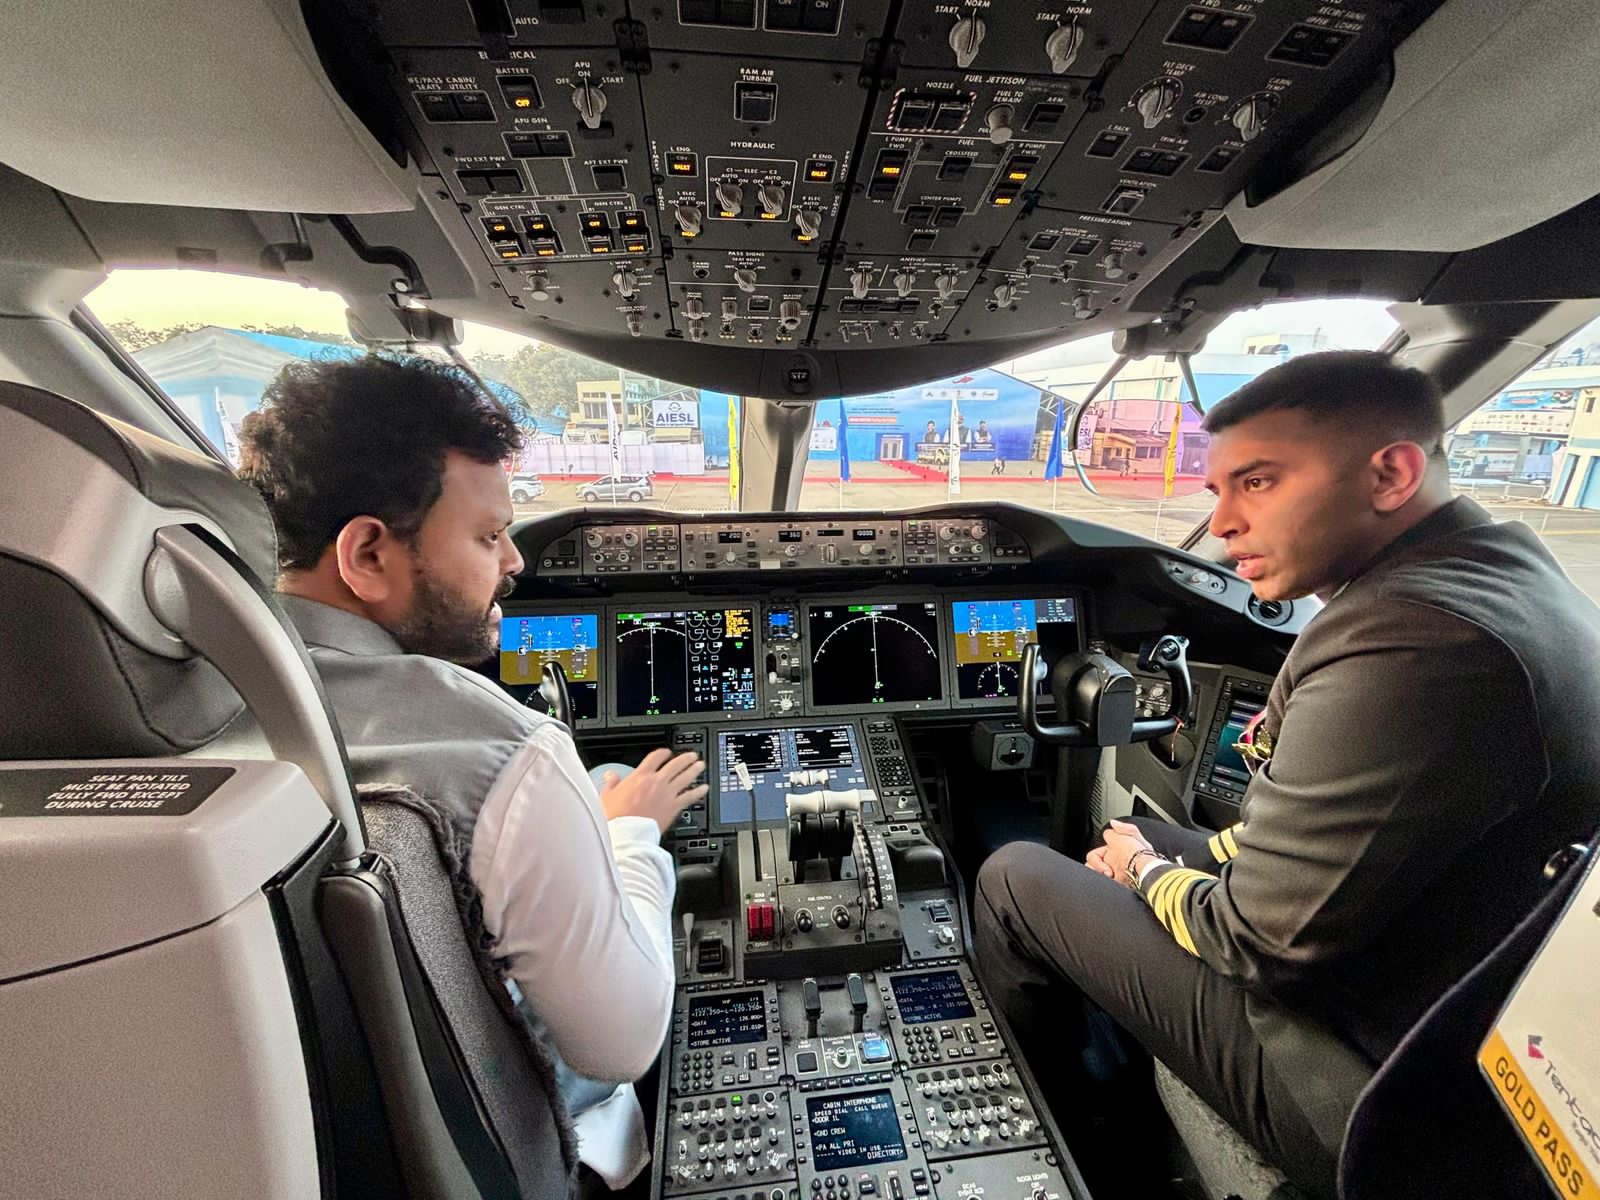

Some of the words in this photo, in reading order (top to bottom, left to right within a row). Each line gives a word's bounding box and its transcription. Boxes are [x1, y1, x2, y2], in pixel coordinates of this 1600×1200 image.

[815, 0, 829, 8] ON
[965, 0, 990, 8] NORM
[935, 5, 959, 14] START
[1066, 6, 1093, 15] NORM
[515, 17, 539, 25] AUTO
[1036, 13, 1060, 21] START
[575, 61, 590, 69] APU
[496, 67, 529, 75] BATTERY
[601, 76, 625, 84] START
[964, 75, 983, 83] FUEL
[985, 77, 1026, 85] JETTISON
[514, 117, 530, 125] APU
[730, 141, 776, 150] HYDRAULIC
[1079, 215, 1132, 226] PRESSURIZATION
[656, 413, 694, 423] AIESL
[61, 783, 104, 791] MUST
[47, 792, 93, 800] FULLY
[44, 801, 107, 809] DURING
[823, 1101, 841, 1109] CABIN
[844, 1097, 877, 1106] INTERPHONE
[1495, 1057, 1536, 1121] GOLD
[1536, 1119, 1583, 1196] PASS
[831, 1127, 845, 1135] CREW
